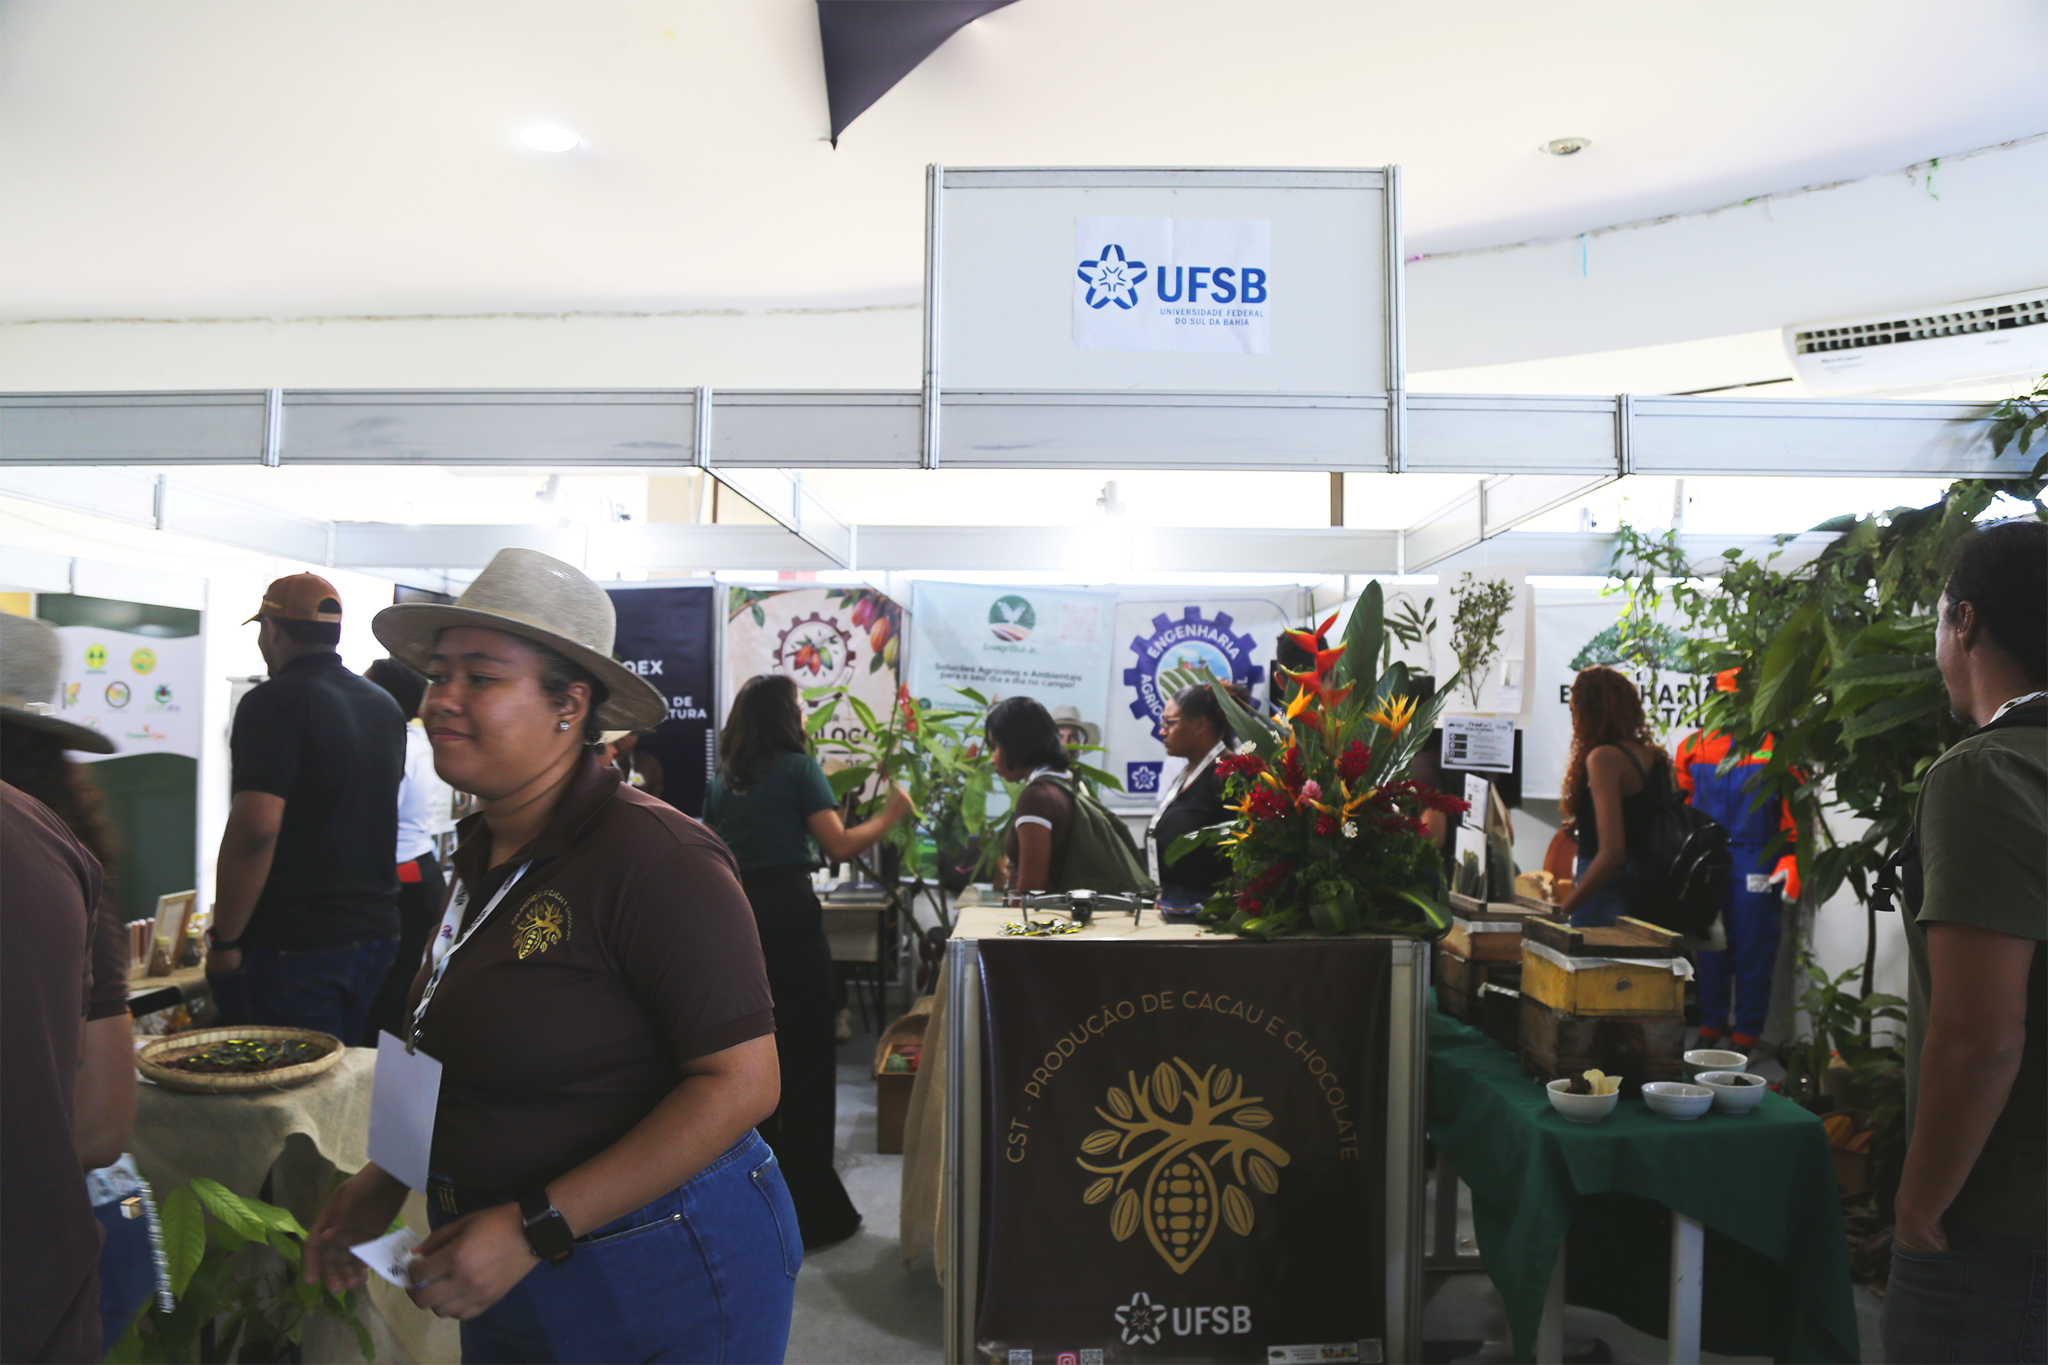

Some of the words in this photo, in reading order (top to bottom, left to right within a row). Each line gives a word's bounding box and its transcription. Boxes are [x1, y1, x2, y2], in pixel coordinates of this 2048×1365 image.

[1157, 265, 1268, 304] UFSB
[1160, 307, 1223, 317] UNIVERSIDADE
[1226, 309, 1264, 318] FEDERAL
[1175, 317, 1188, 325] DO
[1190, 317, 1206, 325] SUL
[1209, 318, 1221, 326] DA
[1223, 318, 1250, 326] BAHIA
[1146, 624, 1241, 660] ENGENHARIA
[1031, 669, 1083, 682] Ambientais
[673, 696, 693, 707] DE
[1006, 1117, 1030, 1163] CST
[1024, 1001, 1135, 1099] PRODUÇÃO
[1141, 991, 1176, 1013] DE
[1182, 990, 1265, 1024] CACAU
[1265, 1015, 1285, 1037] E
[1284, 1030, 1359, 1162] CHOCOLATE
[1172, 1305, 1252, 1337] UFSB
